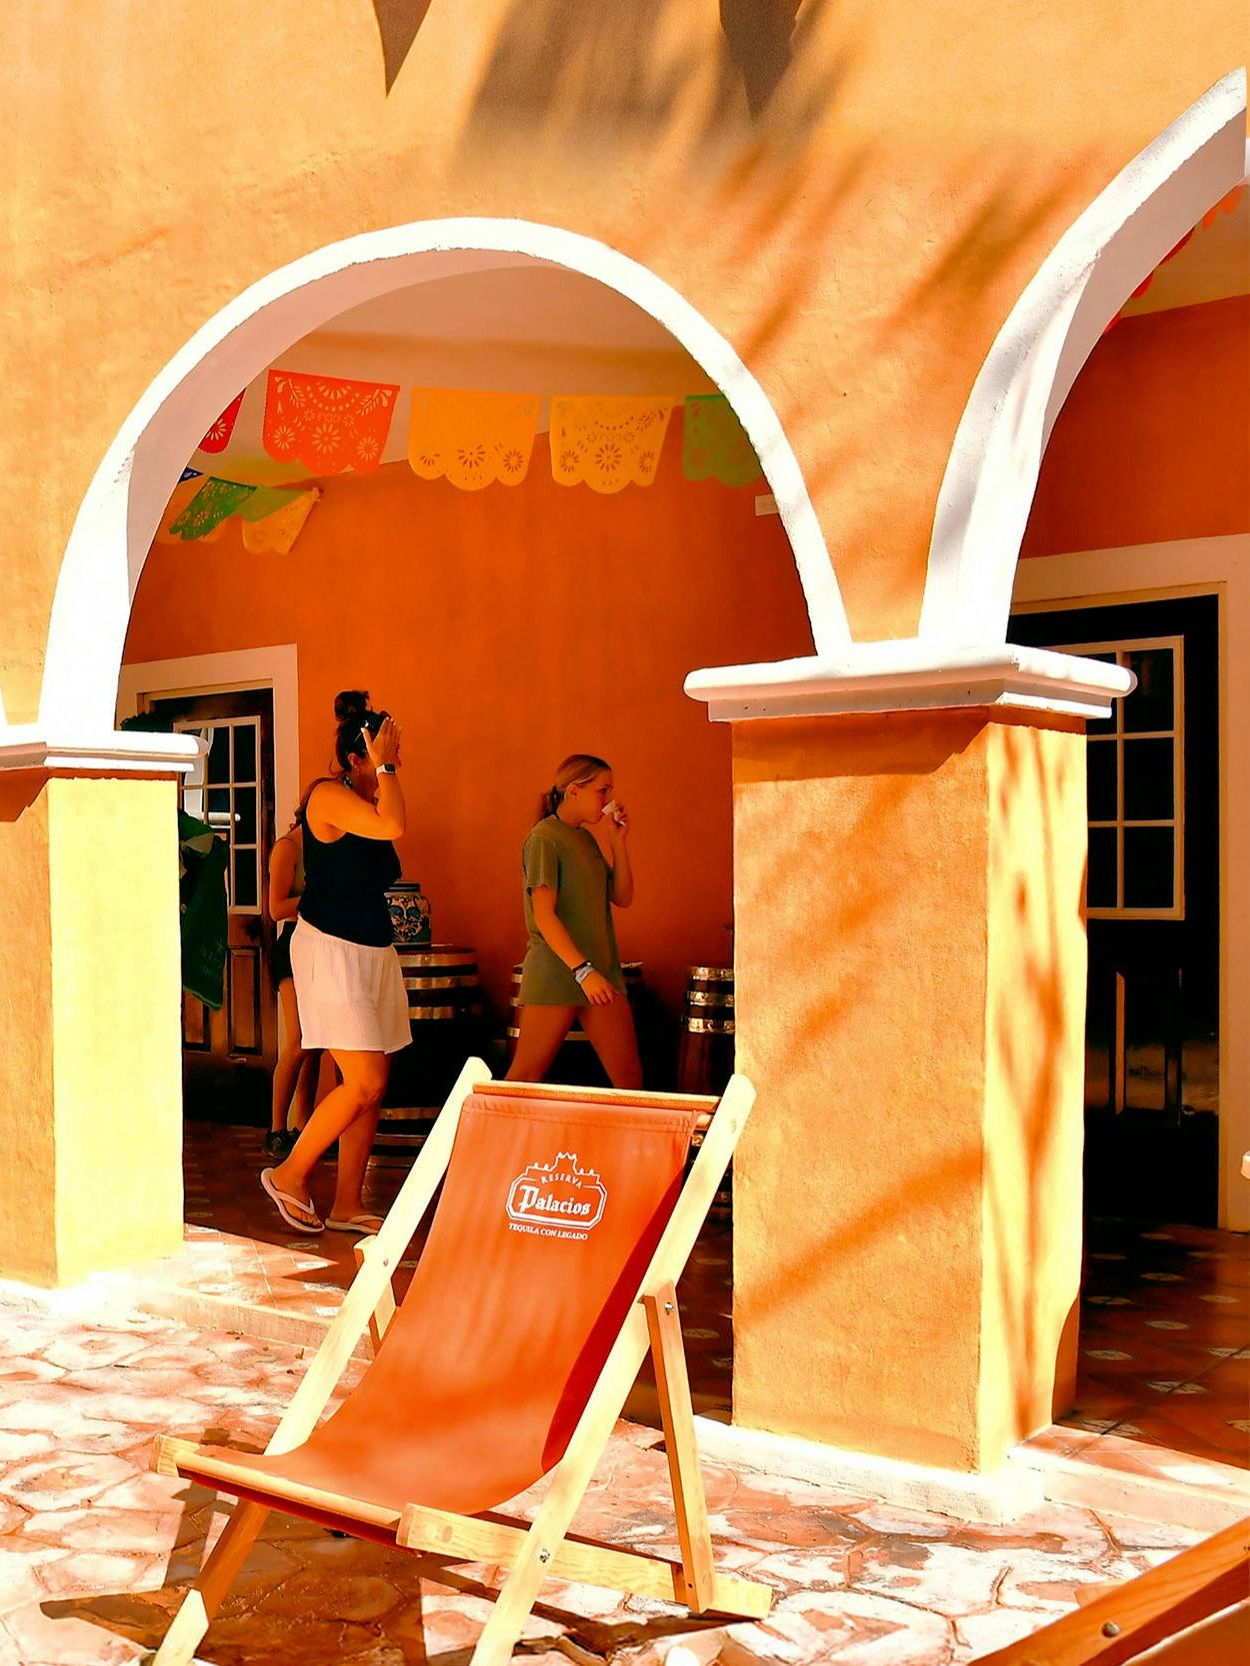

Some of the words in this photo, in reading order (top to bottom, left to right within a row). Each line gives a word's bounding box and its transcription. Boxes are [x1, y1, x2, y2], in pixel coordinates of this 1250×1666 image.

[541, 1173, 583, 1189] RESERVA
[519, 1185, 591, 1216] Palacios
[509, 1223, 540, 1235] TEQUILA
[540, 1228, 557, 1238] CON
[557, 1231, 588, 1241] LEGADO
